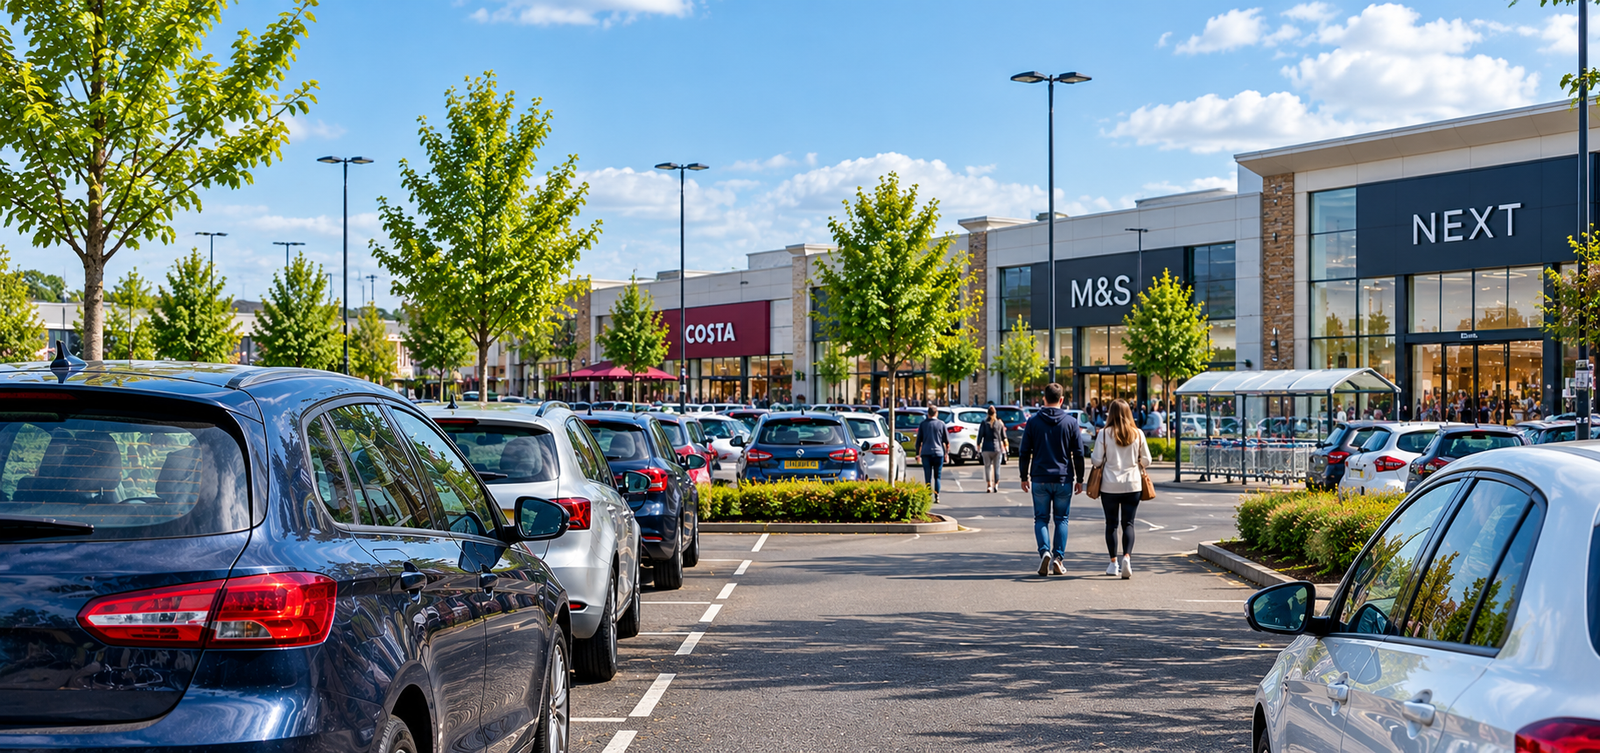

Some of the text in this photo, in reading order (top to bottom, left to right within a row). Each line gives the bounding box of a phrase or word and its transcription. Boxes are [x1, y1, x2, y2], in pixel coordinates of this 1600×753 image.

[1413, 202, 1522, 245] NEXT
[1071, 274, 1131, 308] M&S
[685, 322, 736, 344] COSTA
